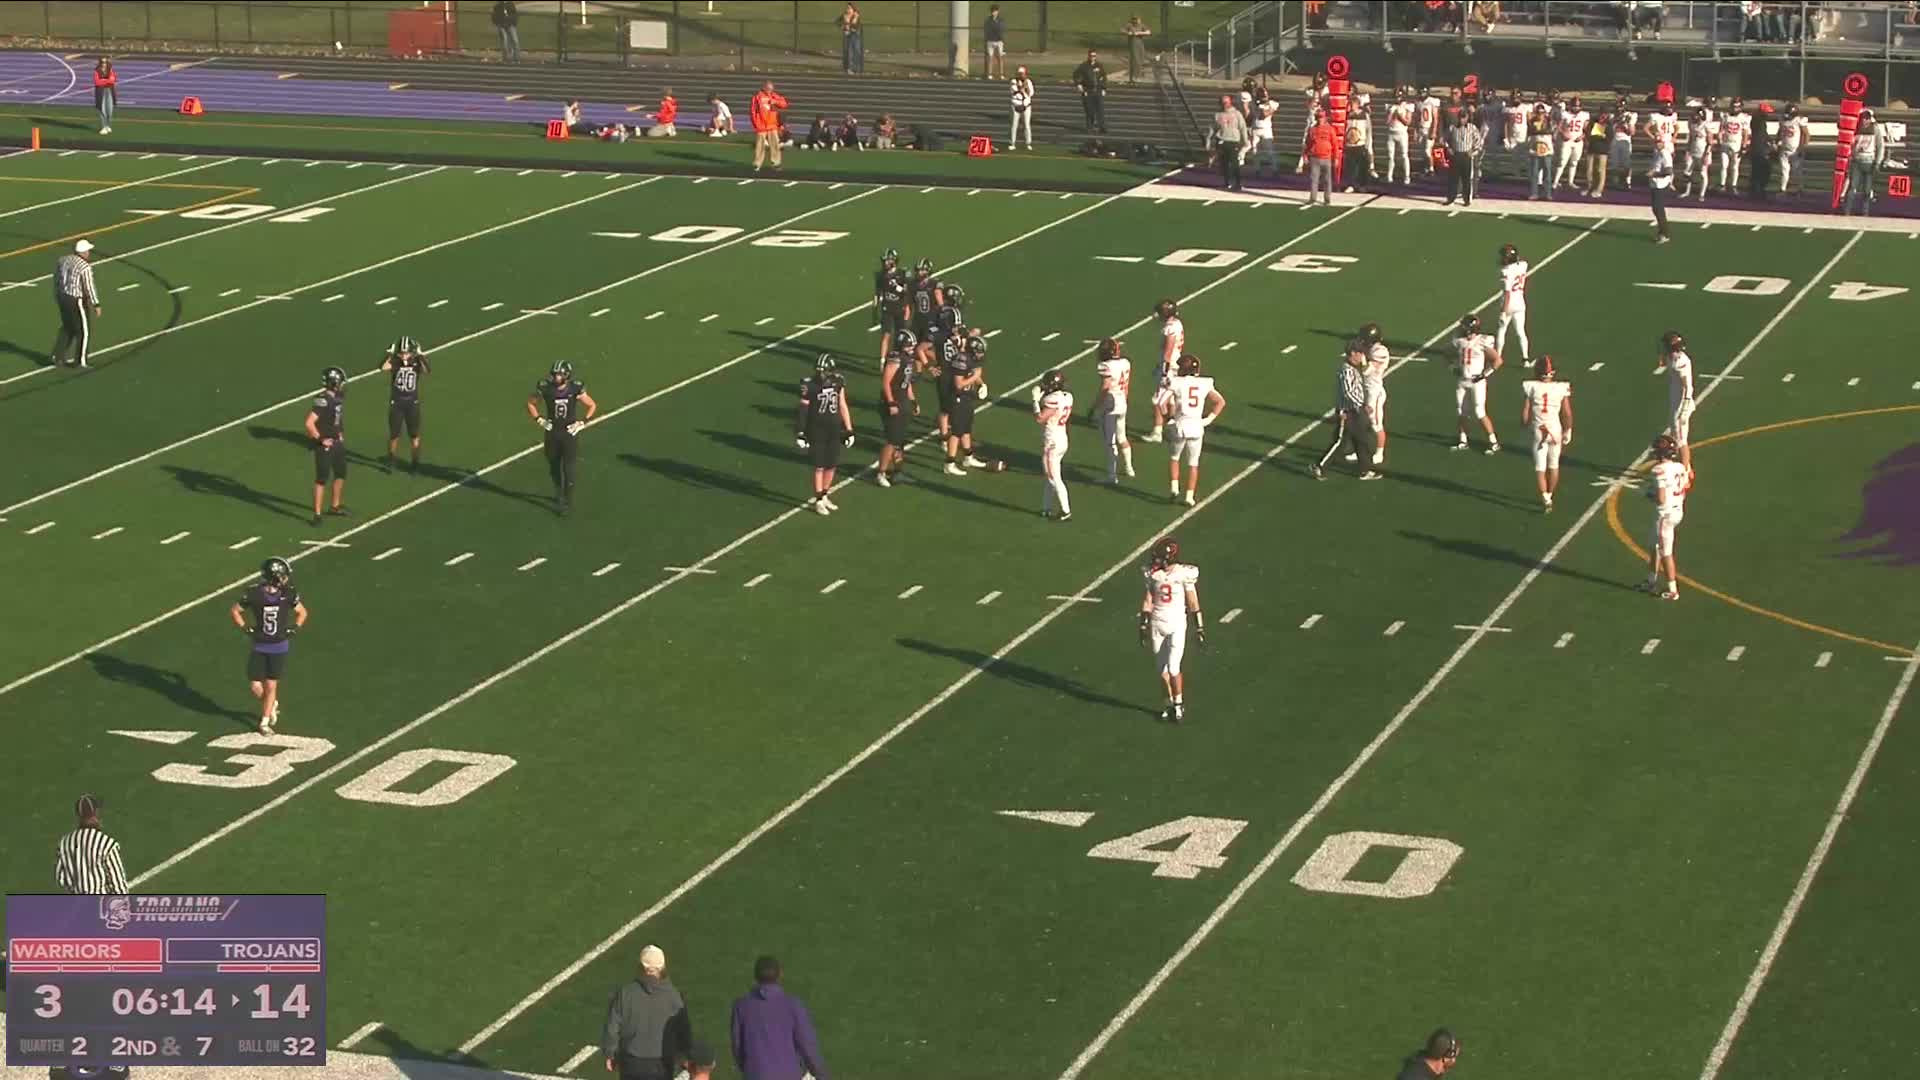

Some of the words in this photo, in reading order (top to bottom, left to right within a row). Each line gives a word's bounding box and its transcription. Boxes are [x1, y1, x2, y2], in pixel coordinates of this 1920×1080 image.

[550, 122, 563, 136] 10
[971, 138, 987, 153] 20
[1890, 177, 1907, 193] 40
[395, 370, 416, 391] 40
[1188, 387, 1199, 407] 5
[1541, 392, 1548, 413] 1
[1160, 584, 1172, 603] 3
[263, 611, 278, 635] 5
[152, 731, 518, 807] 30
[1087, 815, 1464, 899] 40
